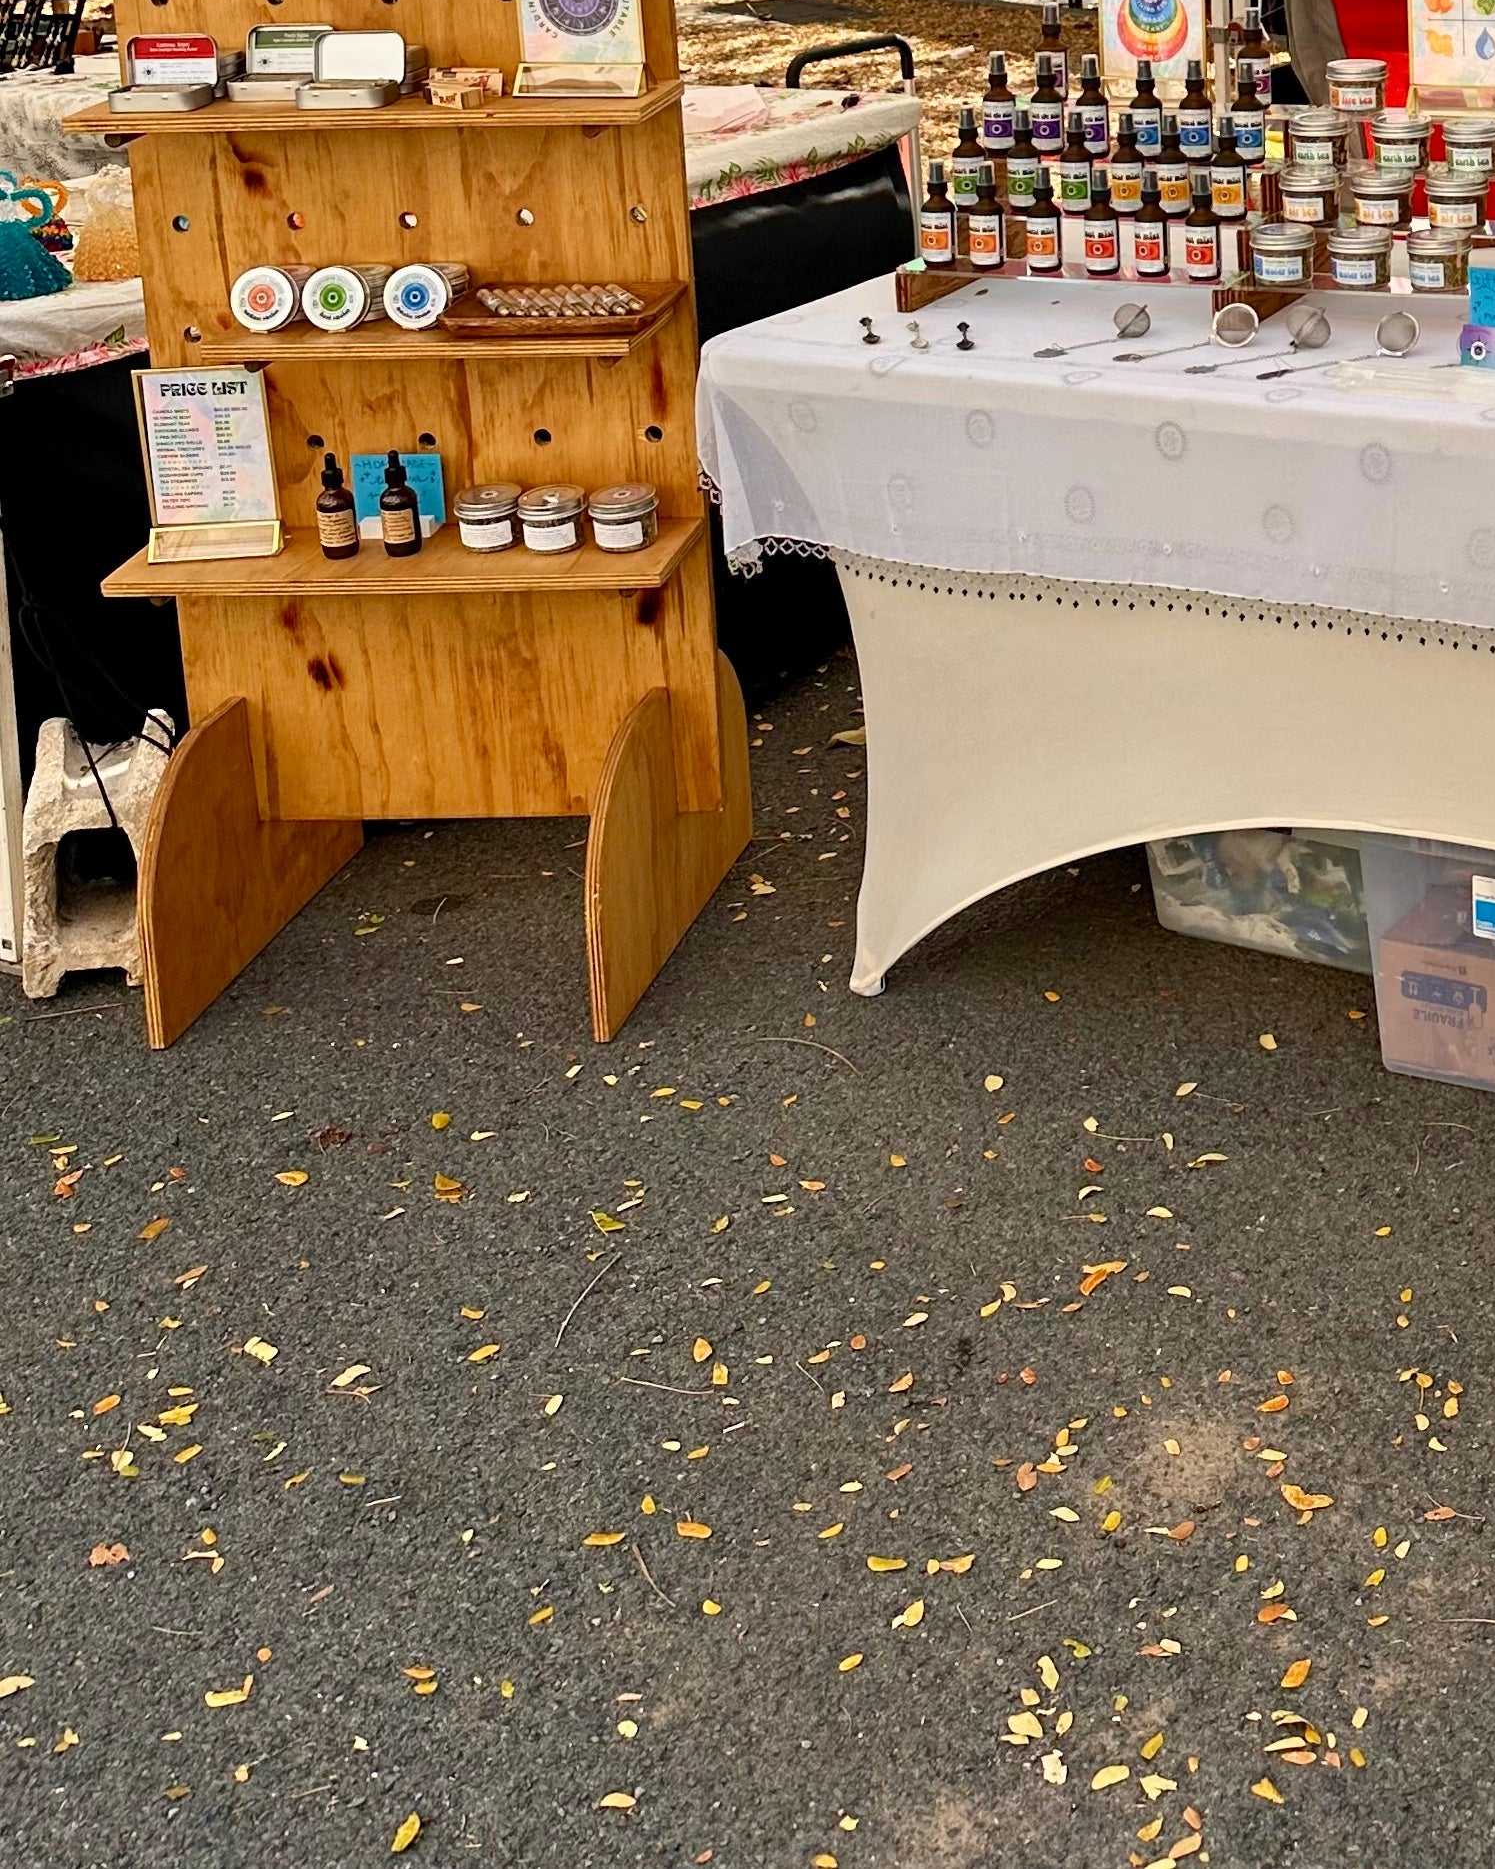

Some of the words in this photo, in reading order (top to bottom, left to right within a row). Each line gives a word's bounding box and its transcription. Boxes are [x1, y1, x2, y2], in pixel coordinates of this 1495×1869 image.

[160, 382, 207, 397] PRICE
[211, 381, 248, 395] LIST
[1413, 1007, 1464, 1029] FRAGILE
